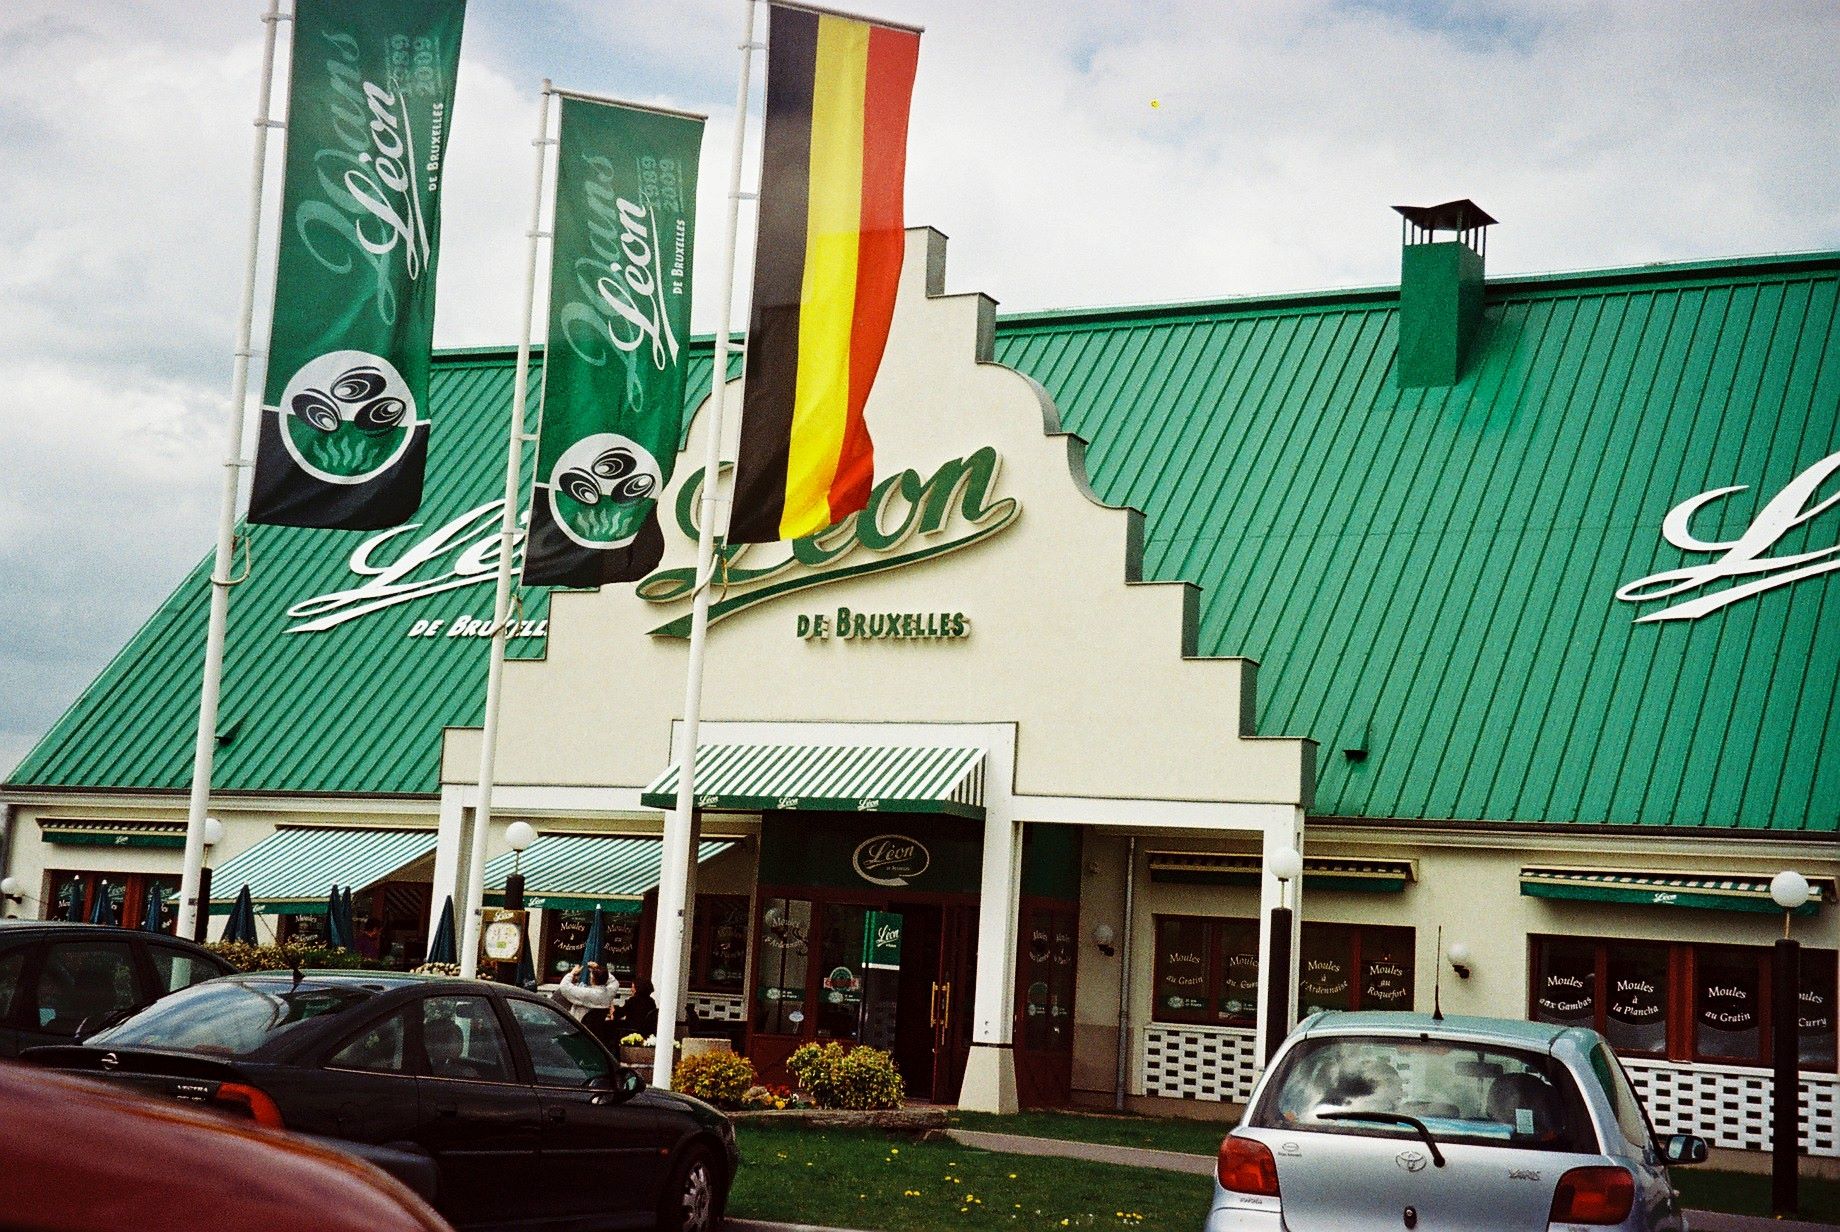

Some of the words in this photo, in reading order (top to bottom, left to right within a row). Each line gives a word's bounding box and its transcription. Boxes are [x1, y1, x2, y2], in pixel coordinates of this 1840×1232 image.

[427, 102, 443, 171] BRUXELLES
[344, 80, 425, 280] Léon
[428, 175, 439, 191] DE
[671, 218, 685, 277] BRUXELLES
[598, 195, 674, 370] Léon
[672, 280, 683, 295] DE
[287, 498, 529, 622] Lé
[407, 619, 445, 637] DE
[446, 614, 548, 637] BRULL
[797, 613, 826, 638] DE
[836, 606, 967, 638] BRUXELLES
[1169, 952, 1200, 964] Moules
[1229, 956, 1259, 967] Moule
[1308, 960, 1340, 972] Moules
[1369, 964, 1403, 976] Moules
[1179, 976, 1203, 985] Gratin
[1547, 975, 1584, 989] Moules
[1617, 980, 1655, 993] Moules
[1367, 986, 1407, 1001] Roquefort
[1632, 995, 1638, 1004] à
[1708, 986, 1747, 999] Moules
[1798, 991, 1824, 1004] ules
[1557, 996, 1592, 1011] Gambas
[1612, 1002, 1622, 1013] la
[1624, 1005, 1659, 1016] Plancha
[1705, 1011, 1718, 1020] au
[1720, 1012, 1751, 1022] Gratin
[1798, 1017, 1827, 1028] Curry
